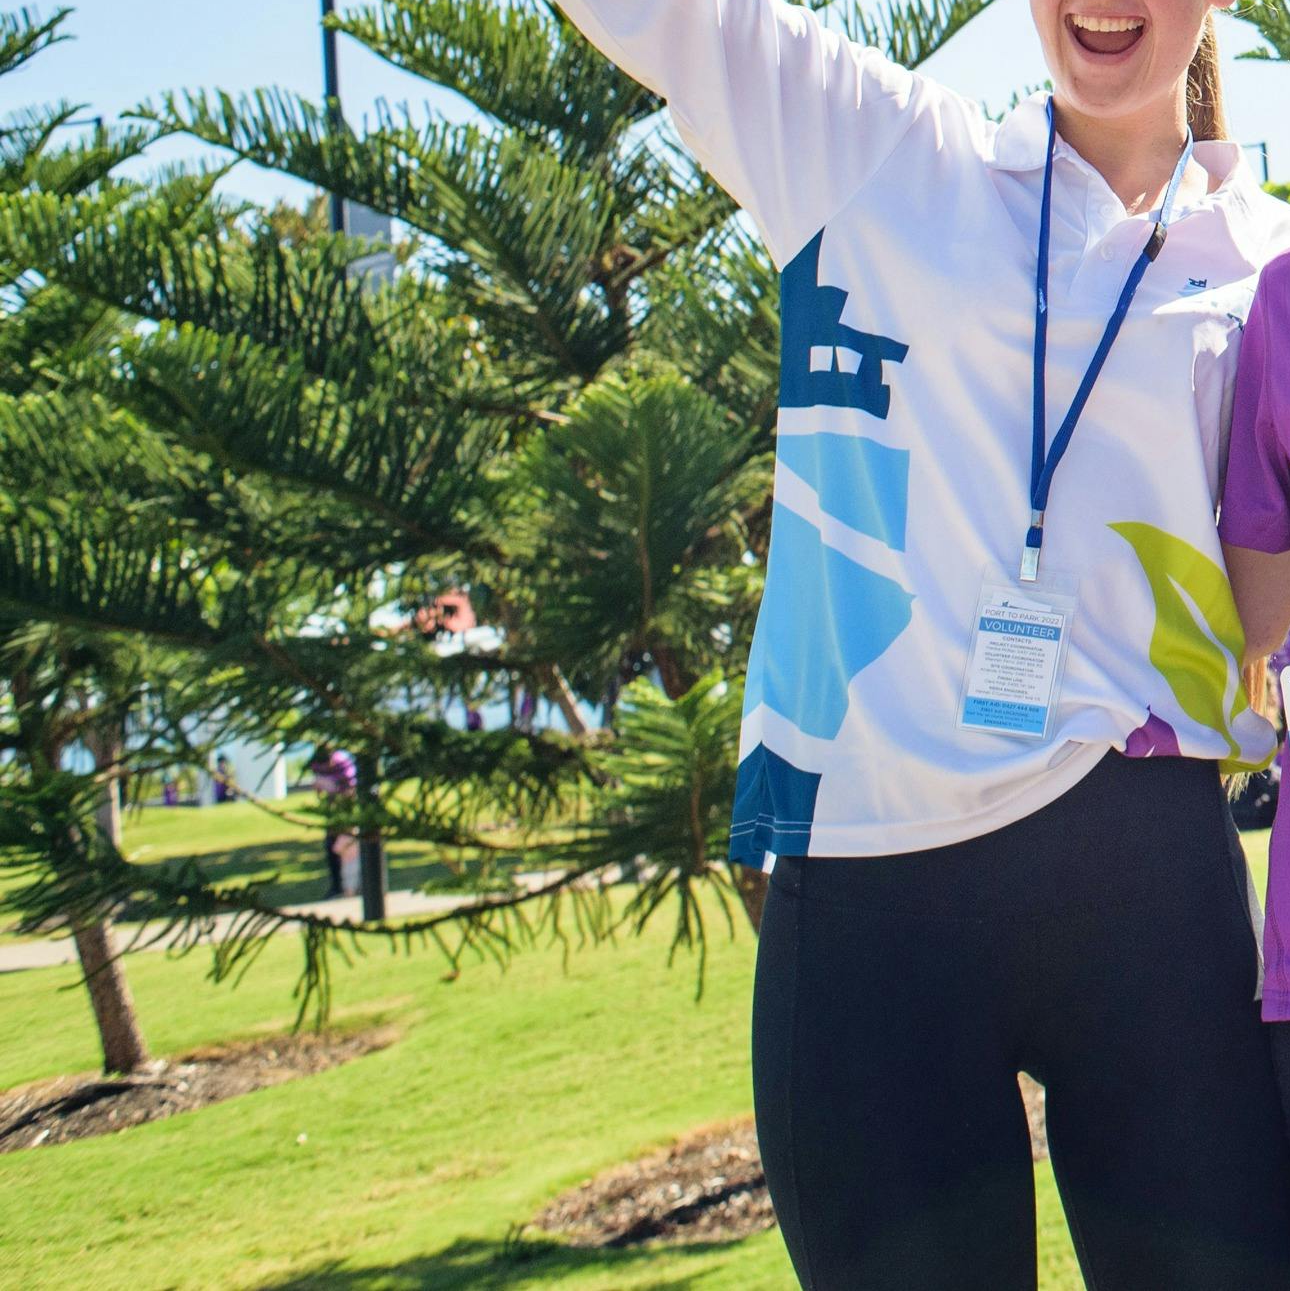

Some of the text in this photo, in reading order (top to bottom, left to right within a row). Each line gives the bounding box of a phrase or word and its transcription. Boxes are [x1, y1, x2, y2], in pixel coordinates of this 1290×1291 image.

[1008, 611, 1018, 619] TO
[1020, 612, 1039, 622] PARK
[1041, 616, 1060, 625] 2022
[985, 620, 1055, 638] VOLUNTEER
